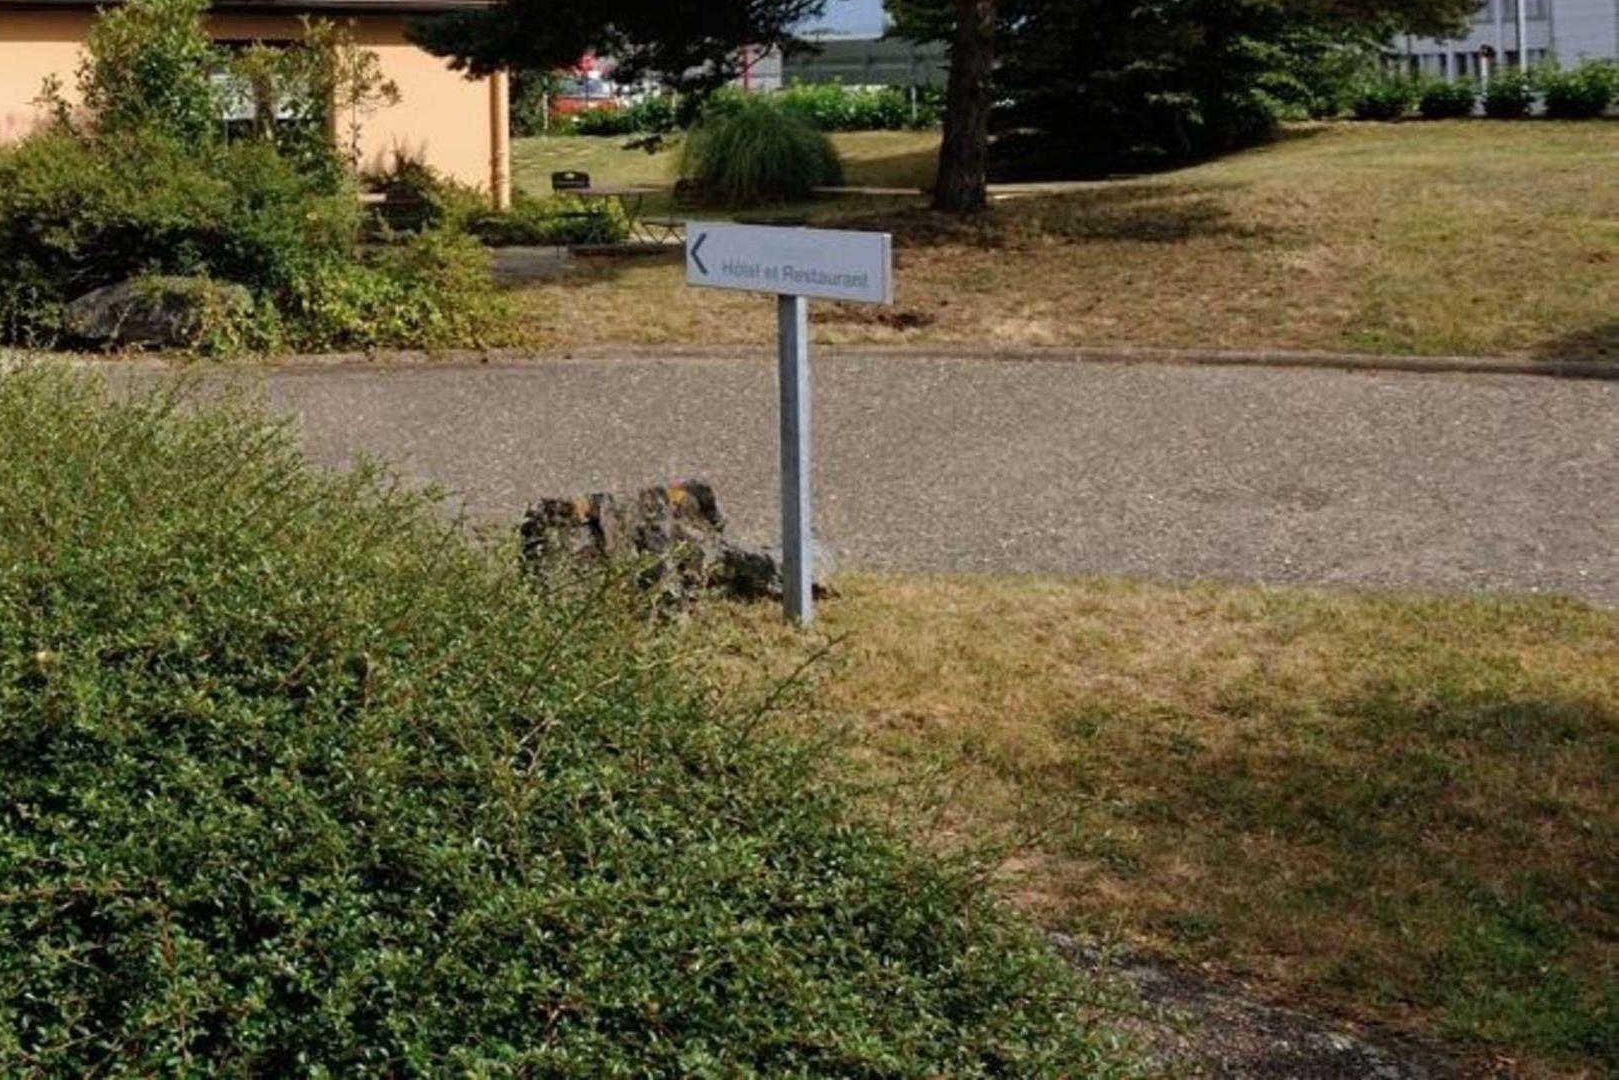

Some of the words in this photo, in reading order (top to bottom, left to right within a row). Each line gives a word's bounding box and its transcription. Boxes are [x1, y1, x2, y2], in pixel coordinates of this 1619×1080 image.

[722, 260, 760, 278] Hôtel
[764, 265, 779, 280] et
[782, 265, 869, 288] Restaurant
